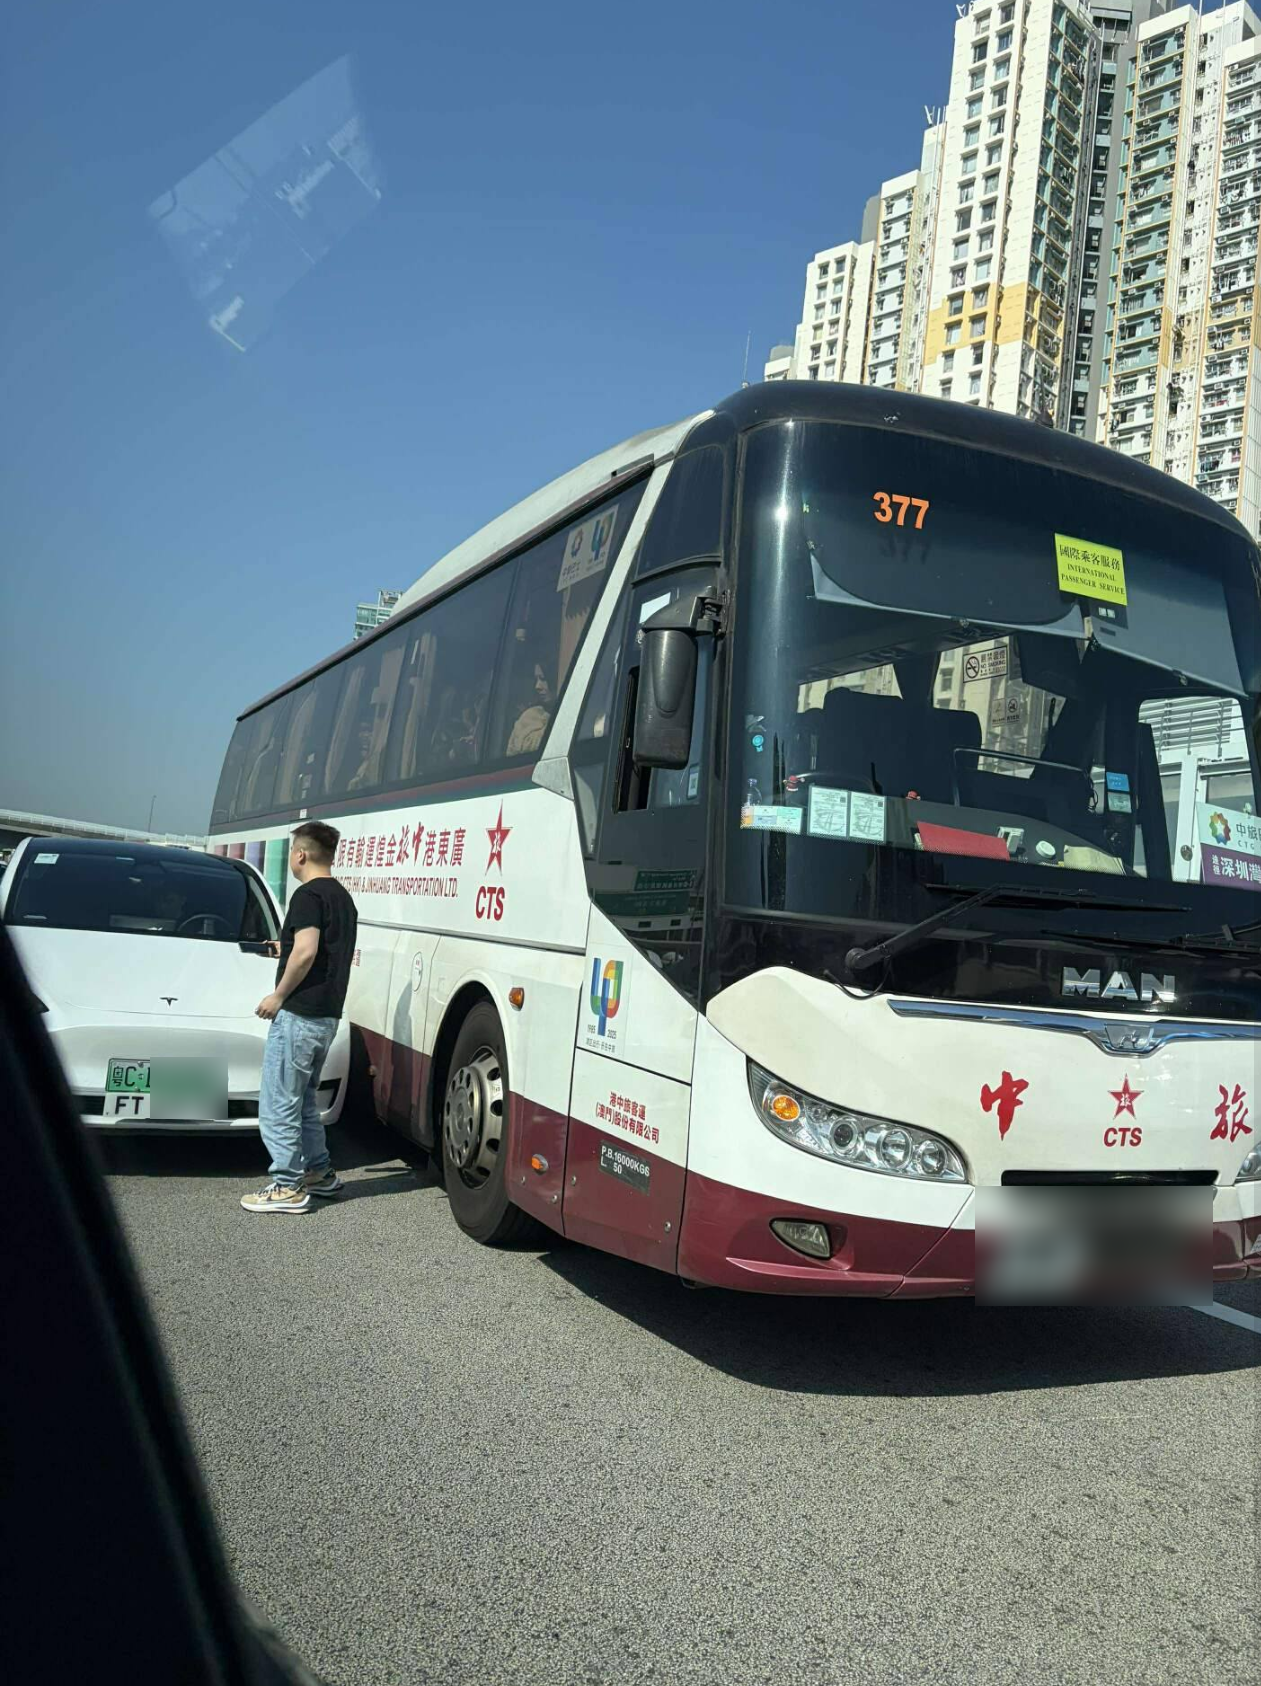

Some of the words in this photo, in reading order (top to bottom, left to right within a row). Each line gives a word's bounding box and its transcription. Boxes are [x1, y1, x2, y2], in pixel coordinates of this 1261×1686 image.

[873, 491, 929, 530] 377
[1059, 544, 1121, 571] 國際乘客服務
[1067, 563, 1116, 581] INTERNATIONAL
[1061, 573, 1097, 588] PASSENGER
[1099, 583, 1125, 595] SERVICE
[391, 877, 444, 897] TRANSPORTATION
[443, 877, 459, 898] LTD.
[475, 885, 506, 922] CTS
[1062, 966, 1177, 1003] MAN
[114, 1096, 145, 1115] FT
[980, 1070, 1030, 1142] 中
[1210, 1083, 1253, 1143] 旅
[1103, 1127, 1143, 1148] CTS
[600, 1156, 608, 1167] L
[613, 1162, 622, 1174] 50
